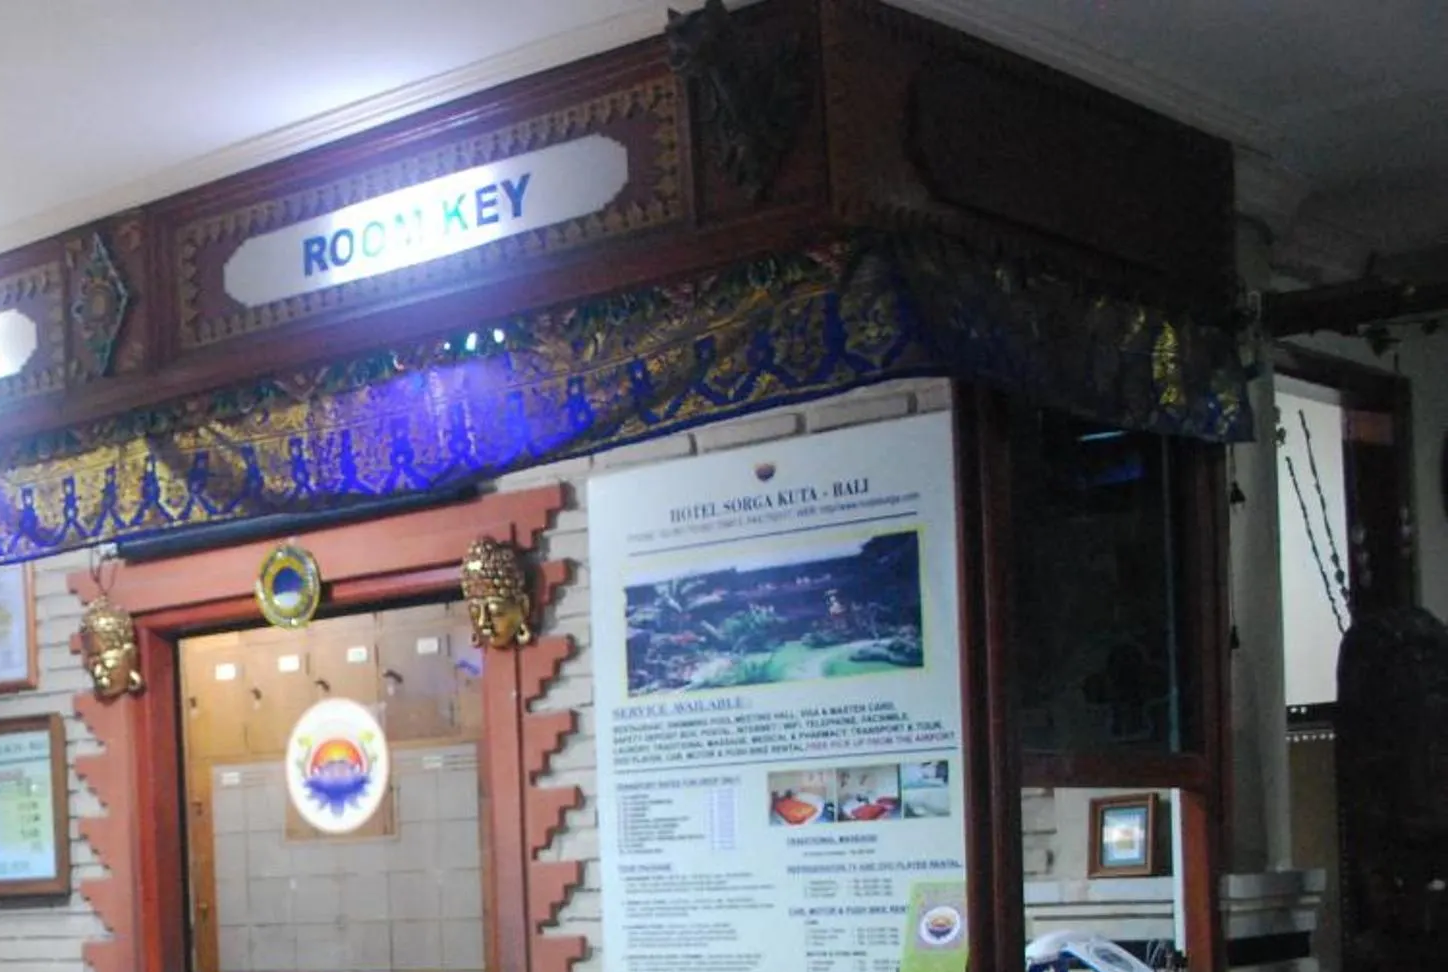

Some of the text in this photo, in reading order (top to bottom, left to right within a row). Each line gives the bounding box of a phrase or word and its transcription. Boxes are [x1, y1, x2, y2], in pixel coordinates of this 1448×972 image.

[442, 173, 532, 234] KEY
[669, 502, 716, 523] HOTEL
[723, 493, 772, 513] SORGA
[777, 486, 818, 506] KUTA
[832, 478, 869, 498] BALI
